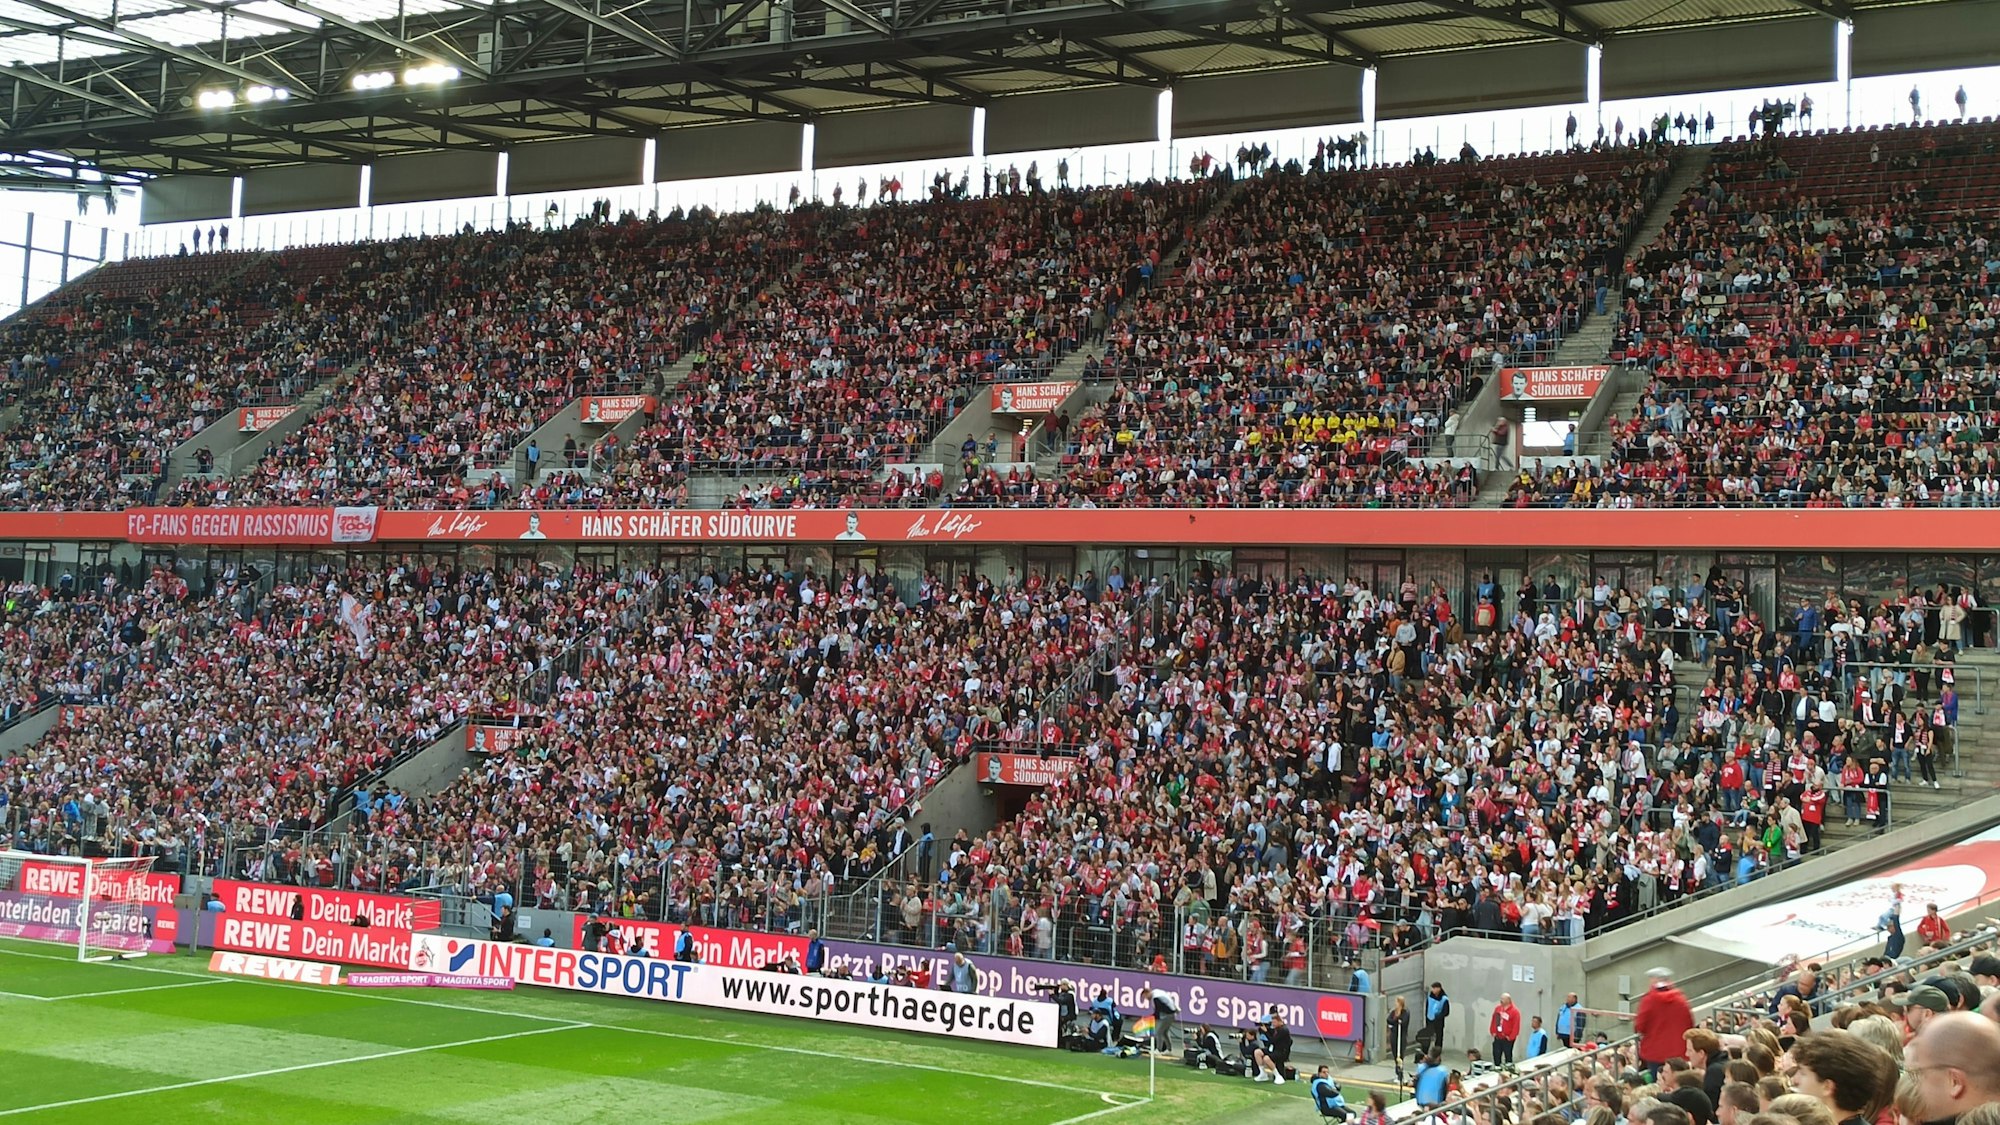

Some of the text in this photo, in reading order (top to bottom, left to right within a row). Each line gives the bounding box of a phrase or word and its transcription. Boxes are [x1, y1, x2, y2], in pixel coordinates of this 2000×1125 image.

[1531, 370, 1558, 382] HANS
[1016, 386, 1037, 397] HANS
[1531, 382, 1584, 396] SÜDKURVE
[602, 399, 620, 408] HANS
[128, 514, 187, 536] FC-FANS
[191, 514, 240, 536] GEGEN
[243, 514, 329, 537] RASSISMUS
[582, 511, 796, 537] HANS SCHÄFER SÜDKURVE
[1013, 758, 1037, 770] HANS
[1013, 770, 1054, 784] SÜDKURV
[25, 867, 175, 904] REWE Dein Markt
[310, 894, 350, 923] Dein
[357, 898, 413, 930] Markt
[223, 919, 292, 952] REWE
[302, 927, 343, 957] Dein
[348, 932, 408, 966] Markt
[219, 953, 326, 985] REWE
[479, 942, 691, 999] INTERSPORT
[359, 975, 400, 984] MAGENTA
[400, 974, 429, 984] SPORT
[442, 976, 482, 986] MAGENTA
[482, 978, 510, 987] SPORT
[722, 976, 1034, 1034] www.sporthaeger.de
[1189, 985, 1209, 1016] &
[1320, 1010, 1348, 1023] REWE
